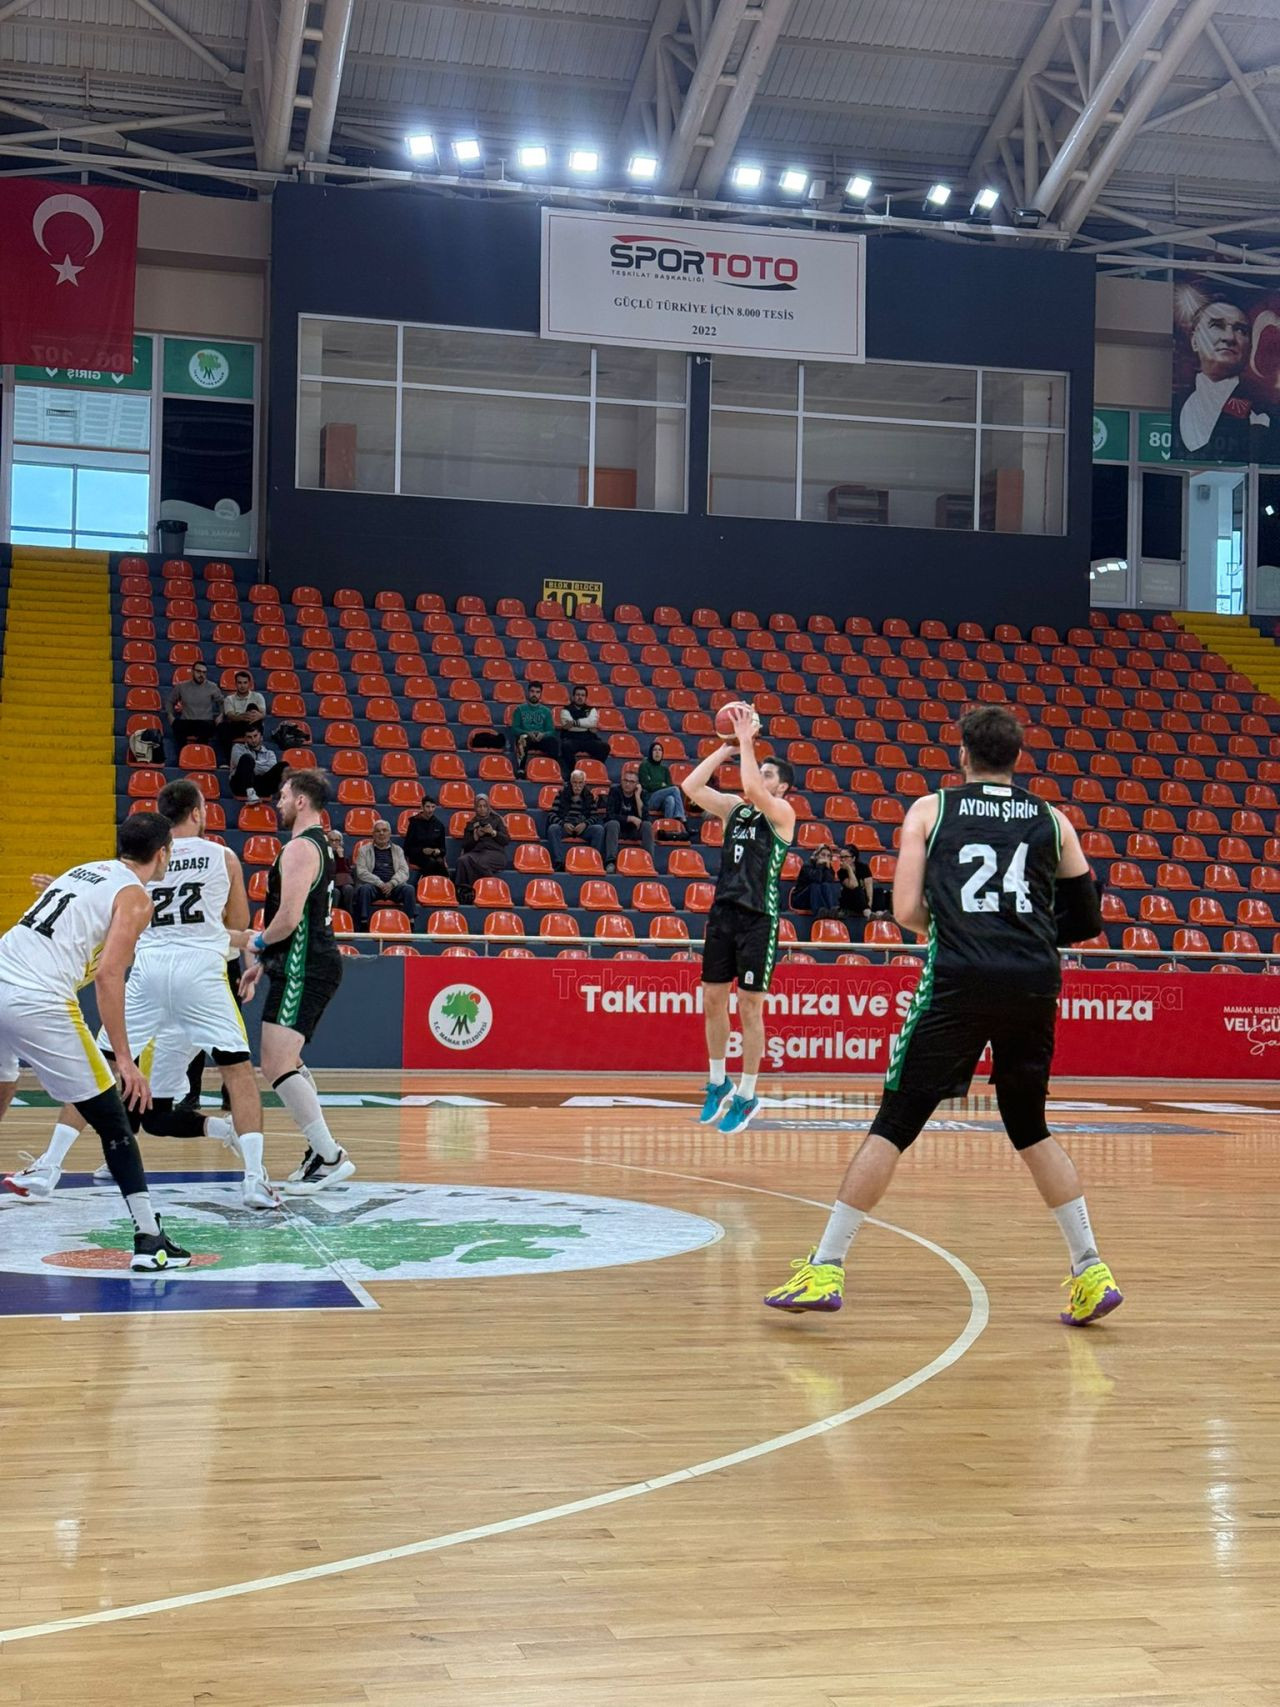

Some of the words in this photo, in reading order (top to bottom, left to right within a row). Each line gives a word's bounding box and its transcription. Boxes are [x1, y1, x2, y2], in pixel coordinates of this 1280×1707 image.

[613, 296, 653, 310] GÜÇLÜ
[656, 300, 707, 314] TÜRKİYE
[710, 303, 734, 317] İÇİN
[737, 306, 760, 318] 8.000
[762, 308, 794, 320] TESİS
[691, 325, 717, 336] 2022
[548, 582, 569, 590] BLOK
[574, 583, 600, 591] BLOCK
[958, 798, 1000, 818] AYDIN
[1002, 799, 1039, 822] ŞİRİN
[958, 841, 1034, 914] 24
[19, 887, 77, 940] 11
[151, 881, 205, 928] 22
[580, 985, 840, 1016] Takımlrmıza
[847, 994, 889, 1017] ve
[1223, 1006, 1253, 1014] MAMAK
[1223, 1015, 1258, 1032] VELİ
[440, 1032, 460, 1045] MAMAK
[725, 1031, 882, 1068] Bşarılar
